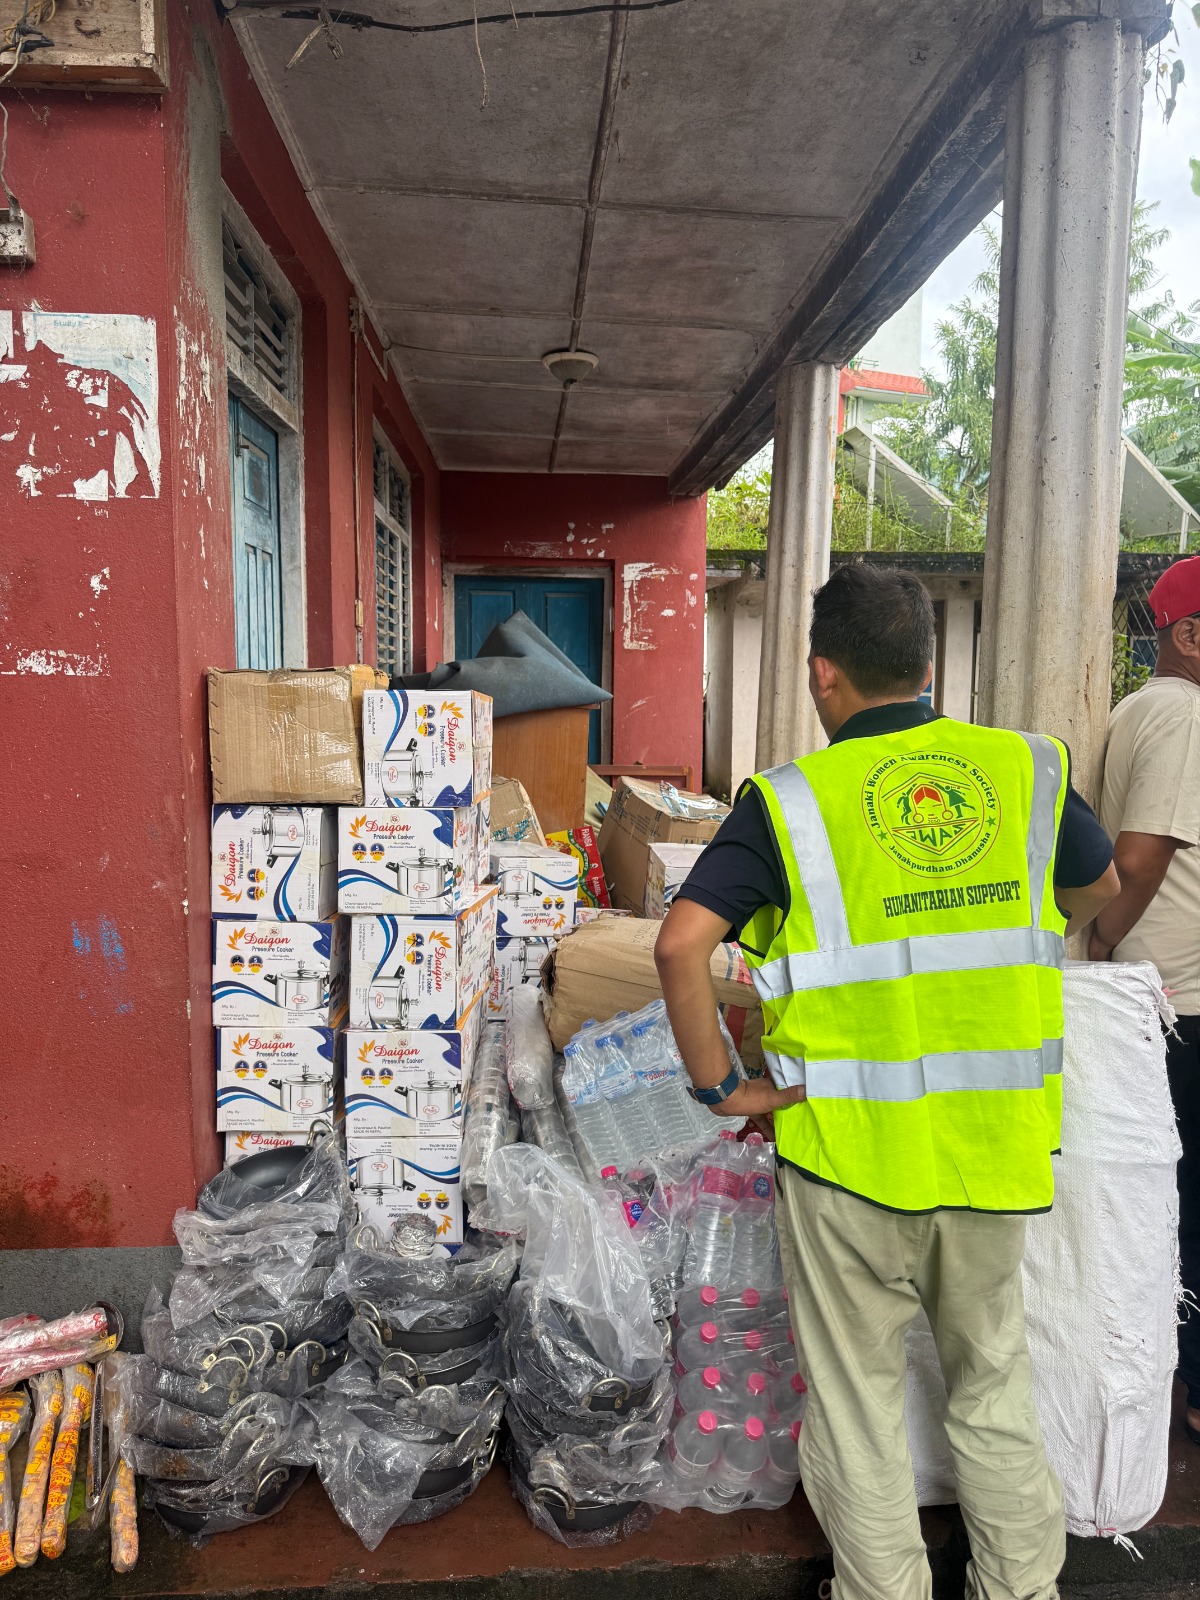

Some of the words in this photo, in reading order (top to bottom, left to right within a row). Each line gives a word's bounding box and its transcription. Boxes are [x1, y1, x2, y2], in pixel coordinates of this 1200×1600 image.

[445, 717, 459, 764] Daigon
[900, 754, 967, 769] Awareness
[867, 758, 897, 787] Women
[969, 768, 996, 810] Society
[864, 791, 880, 828] Janaki
[365, 819, 411, 836] Daigon
[223, 841, 239, 887] Daigon
[966, 880, 1020, 906] SUPPORT
[523, 915, 555, 926] Daigon
[243, 932, 291, 948] Daigon
[431, 947, 447, 992] Daigon
[248, 1037, 295, 1054] Daigon
[373, 1044, 420, 1059] Daigon
[251, 1133, 295, 1148] Daigon
